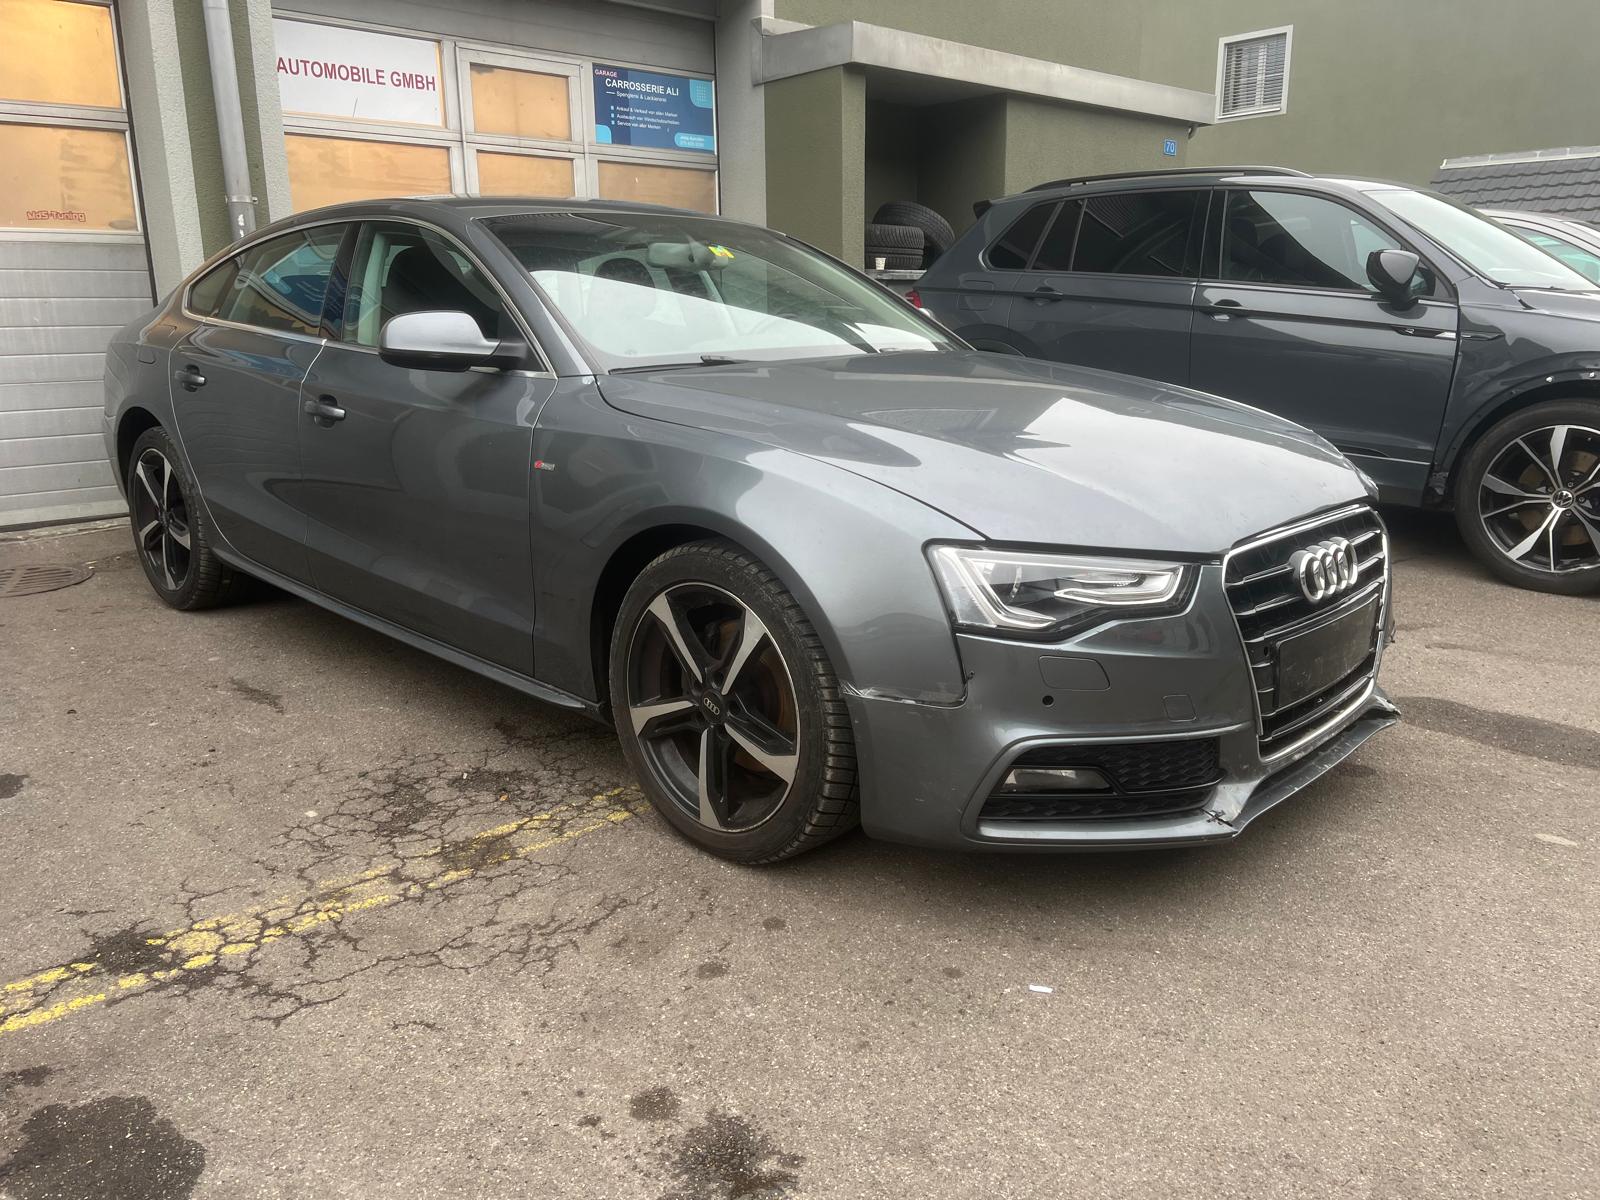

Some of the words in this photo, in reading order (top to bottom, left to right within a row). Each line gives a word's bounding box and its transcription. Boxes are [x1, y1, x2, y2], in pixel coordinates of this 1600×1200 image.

[276, 57, 386, 86] AUTOMOBILE
[390, 71, 436, 91] GMBH
[594, 69, 618, 78] GARAGE
[605, 78, 665, 94] CARROSSERIE
[666, 86, 679, 96] ALI
[1166, 141, 1175, 153] 70
